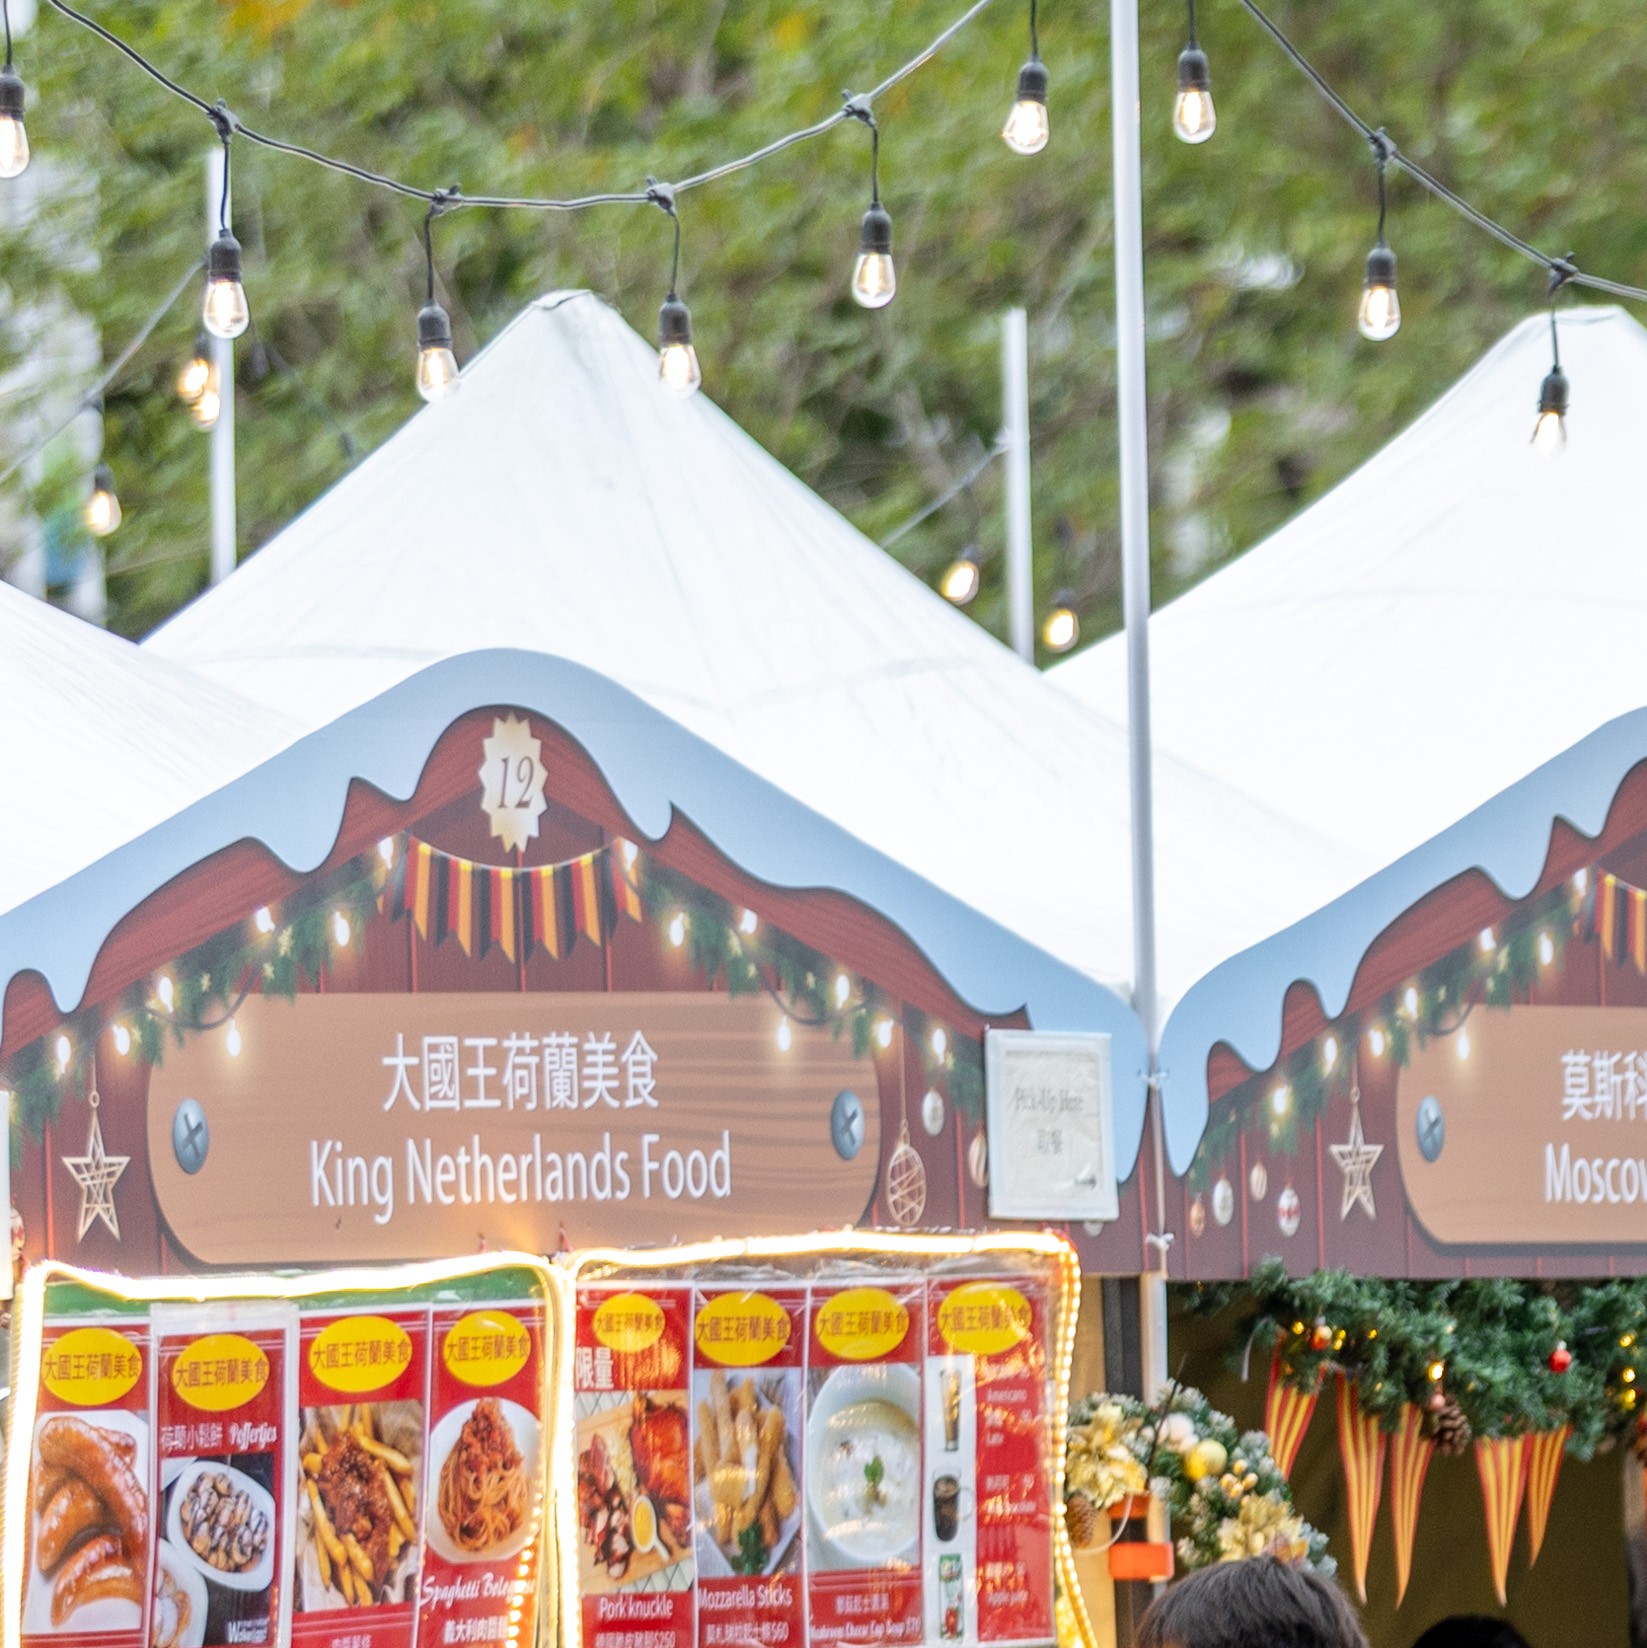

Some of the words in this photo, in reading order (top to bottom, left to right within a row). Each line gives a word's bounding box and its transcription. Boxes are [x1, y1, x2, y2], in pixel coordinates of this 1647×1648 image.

[497, 755, 535, 809] 12
[381, 1029, 660, 1112] 大國王荷蘭美食
[310, 1139, 395, 1225] King
[406, 1131, 632, 1205] Netherlands
[641, 1129, 732, 1200] Food
[697, 1315, 791, 1344] 大國王荷蘭美食
[818, 1308, 909, 1338] 大國王荷蘭美食
[312, 1338, 411, 1372] 大國王荷蘭美食
[446, 1332, 531, 1363] 大國王荷蘭美食
[44, 1353, 142, 1382] 大國王荷蘭美食
[175, 1356, 270, 1388] 大國王荷蘭美食
[575, 1346, 615, 1390] 限量
[420, 1575, 482, 1612] Spaghetti
[600, 1596, 628, 1621] Pork
[627, 1594, 674, 1619] knuckle
[698, 1586, 756, 1610] Mozzarella
[756, 1584, 793, 1609] Sticks
